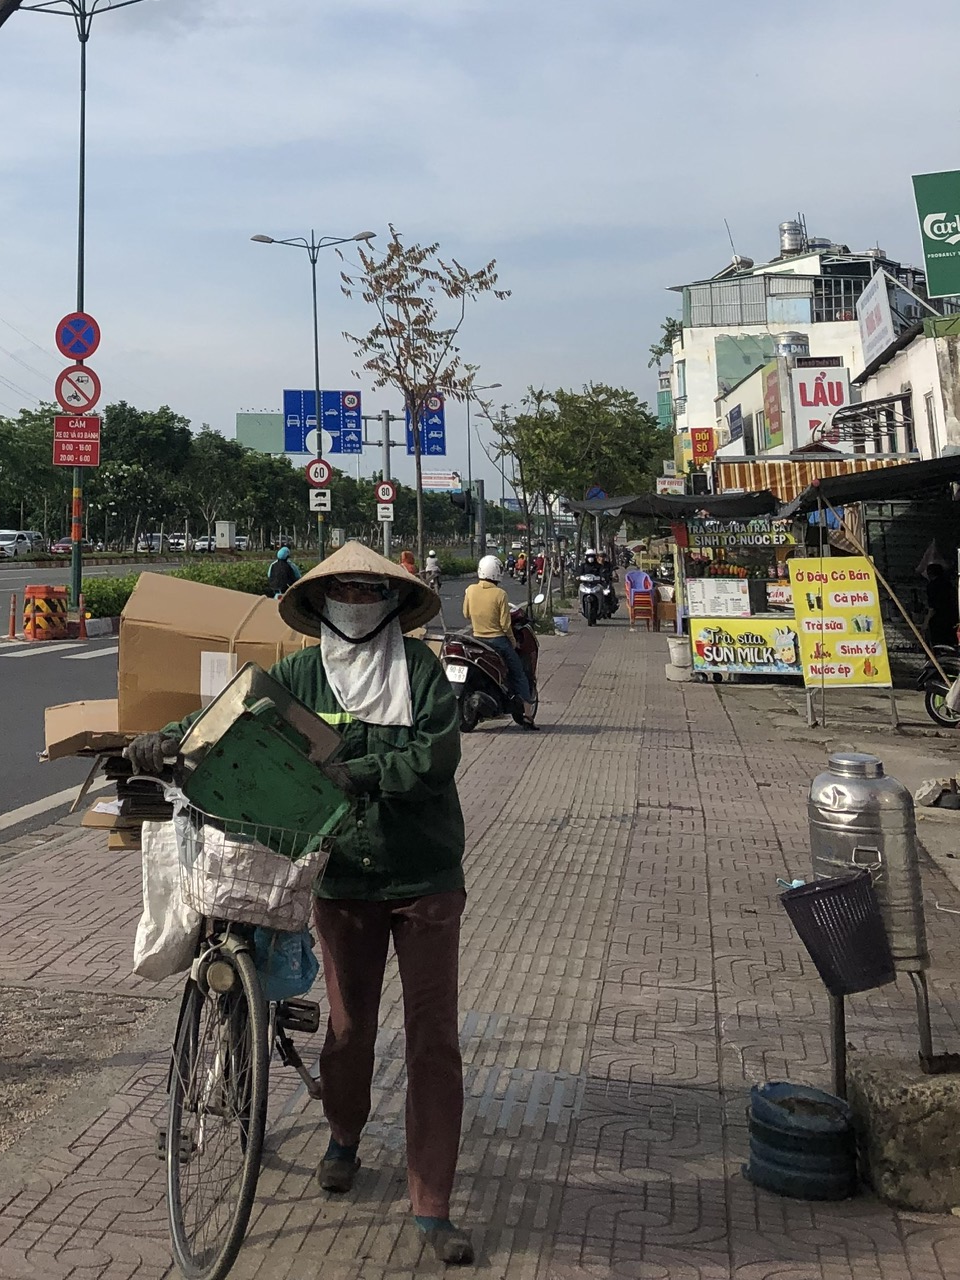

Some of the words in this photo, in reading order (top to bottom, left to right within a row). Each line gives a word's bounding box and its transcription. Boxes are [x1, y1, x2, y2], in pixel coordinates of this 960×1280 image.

[927, 251, 956, 259] PROBABLY
[798, 371, 845, 407] LẨU
[346, 397, 356, 405] 50
[68, 417, 86, 428] CẤM
[313, 467, 325, 479] 60
[381, 487, 390, 497] 80
[694, 535, 720, 546] SINH
[795, 568, 805, 582] Ở
[806, 570, 829, 584] Đây
[831, 570, 846, 581] Có
[848, 569, 870, 581] Bán
[833, 593, 848, 603] Cà
[851, 592, 869, 605] phê
[805, 620, 823, 630] Trà
[824, 620, 843, 630] sữa
[703, 626, 733, 645] Trà
[736, 632, 765, 645] sữa
[703, 646, 734, 662] SUN
[737, 646, 774, 663] MILK
[840, 644, 862, 655] Sinh
[864, 643, 877, 654] tố
[810, 664, 836, 675] Nước
[837, 664, 851, 677] ép
